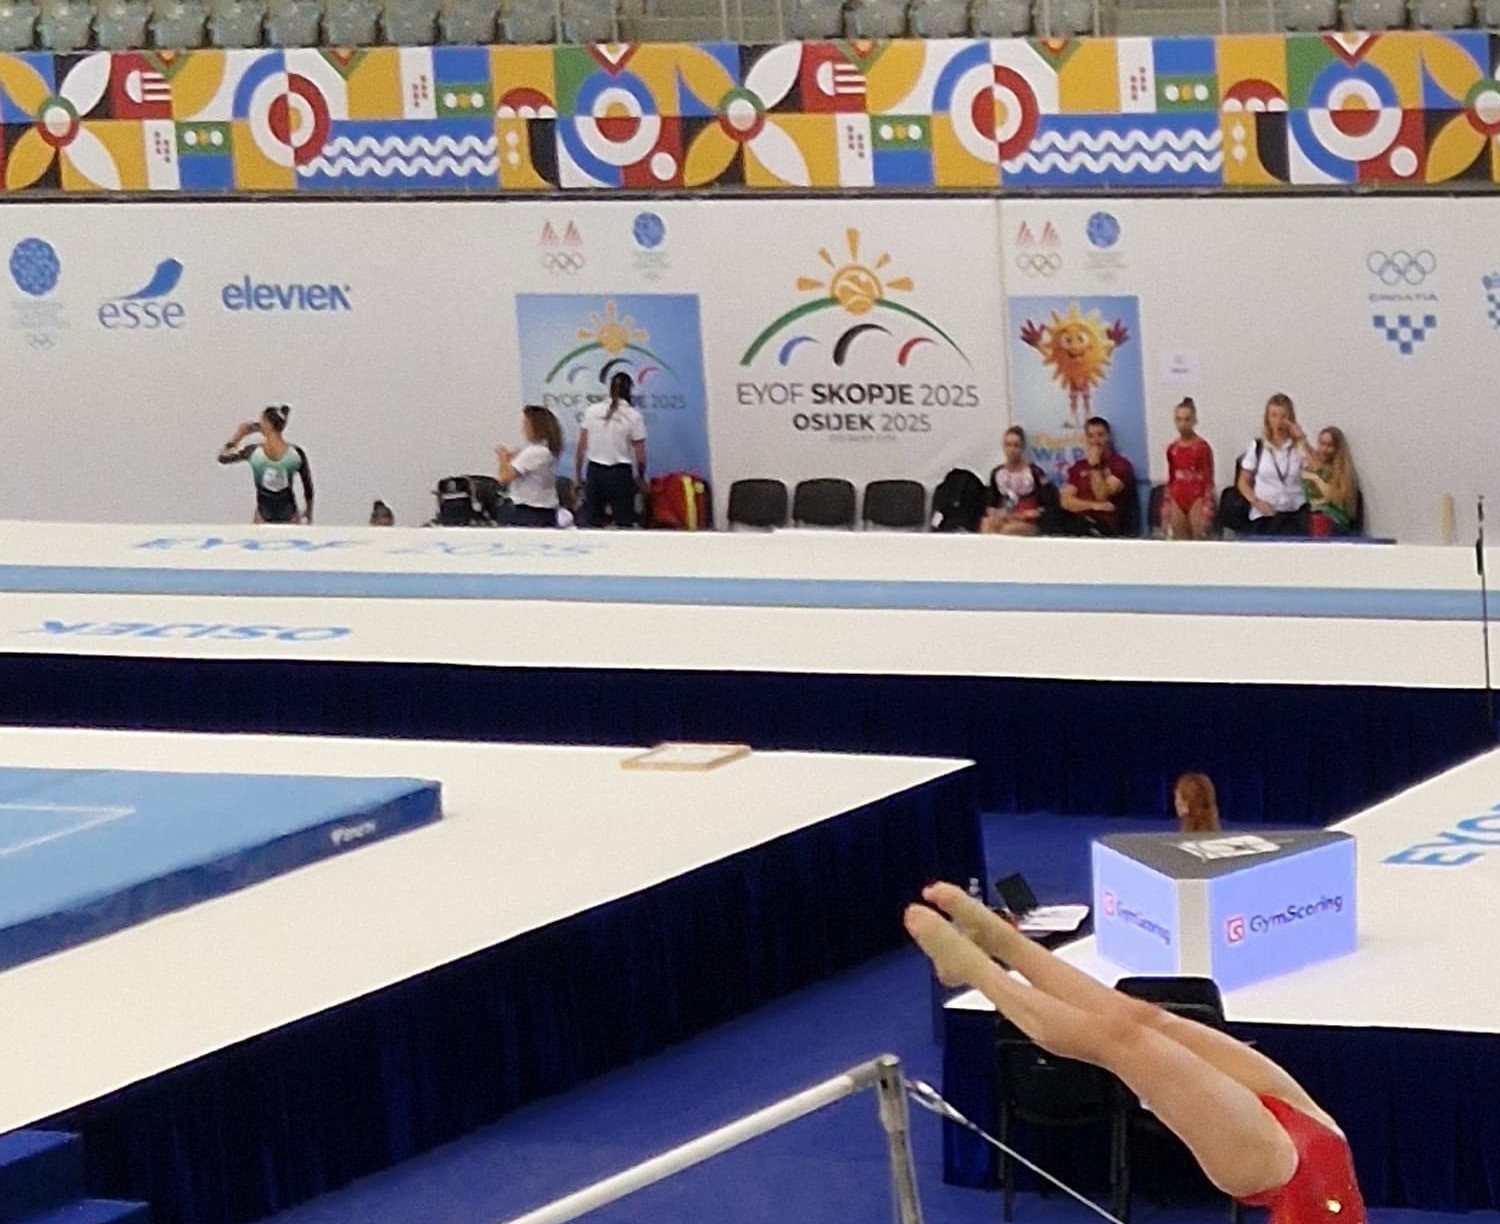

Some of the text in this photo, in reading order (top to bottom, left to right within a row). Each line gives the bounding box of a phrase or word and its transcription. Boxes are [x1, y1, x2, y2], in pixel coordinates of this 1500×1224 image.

[98, 301, 185, 328] esse
[736, 383, 980, 407] EYOF SKOPJE 2025
[792, 413, 933, 432] OSIJEK 2025
[1250, 895, 1344, 935] GymScoring
